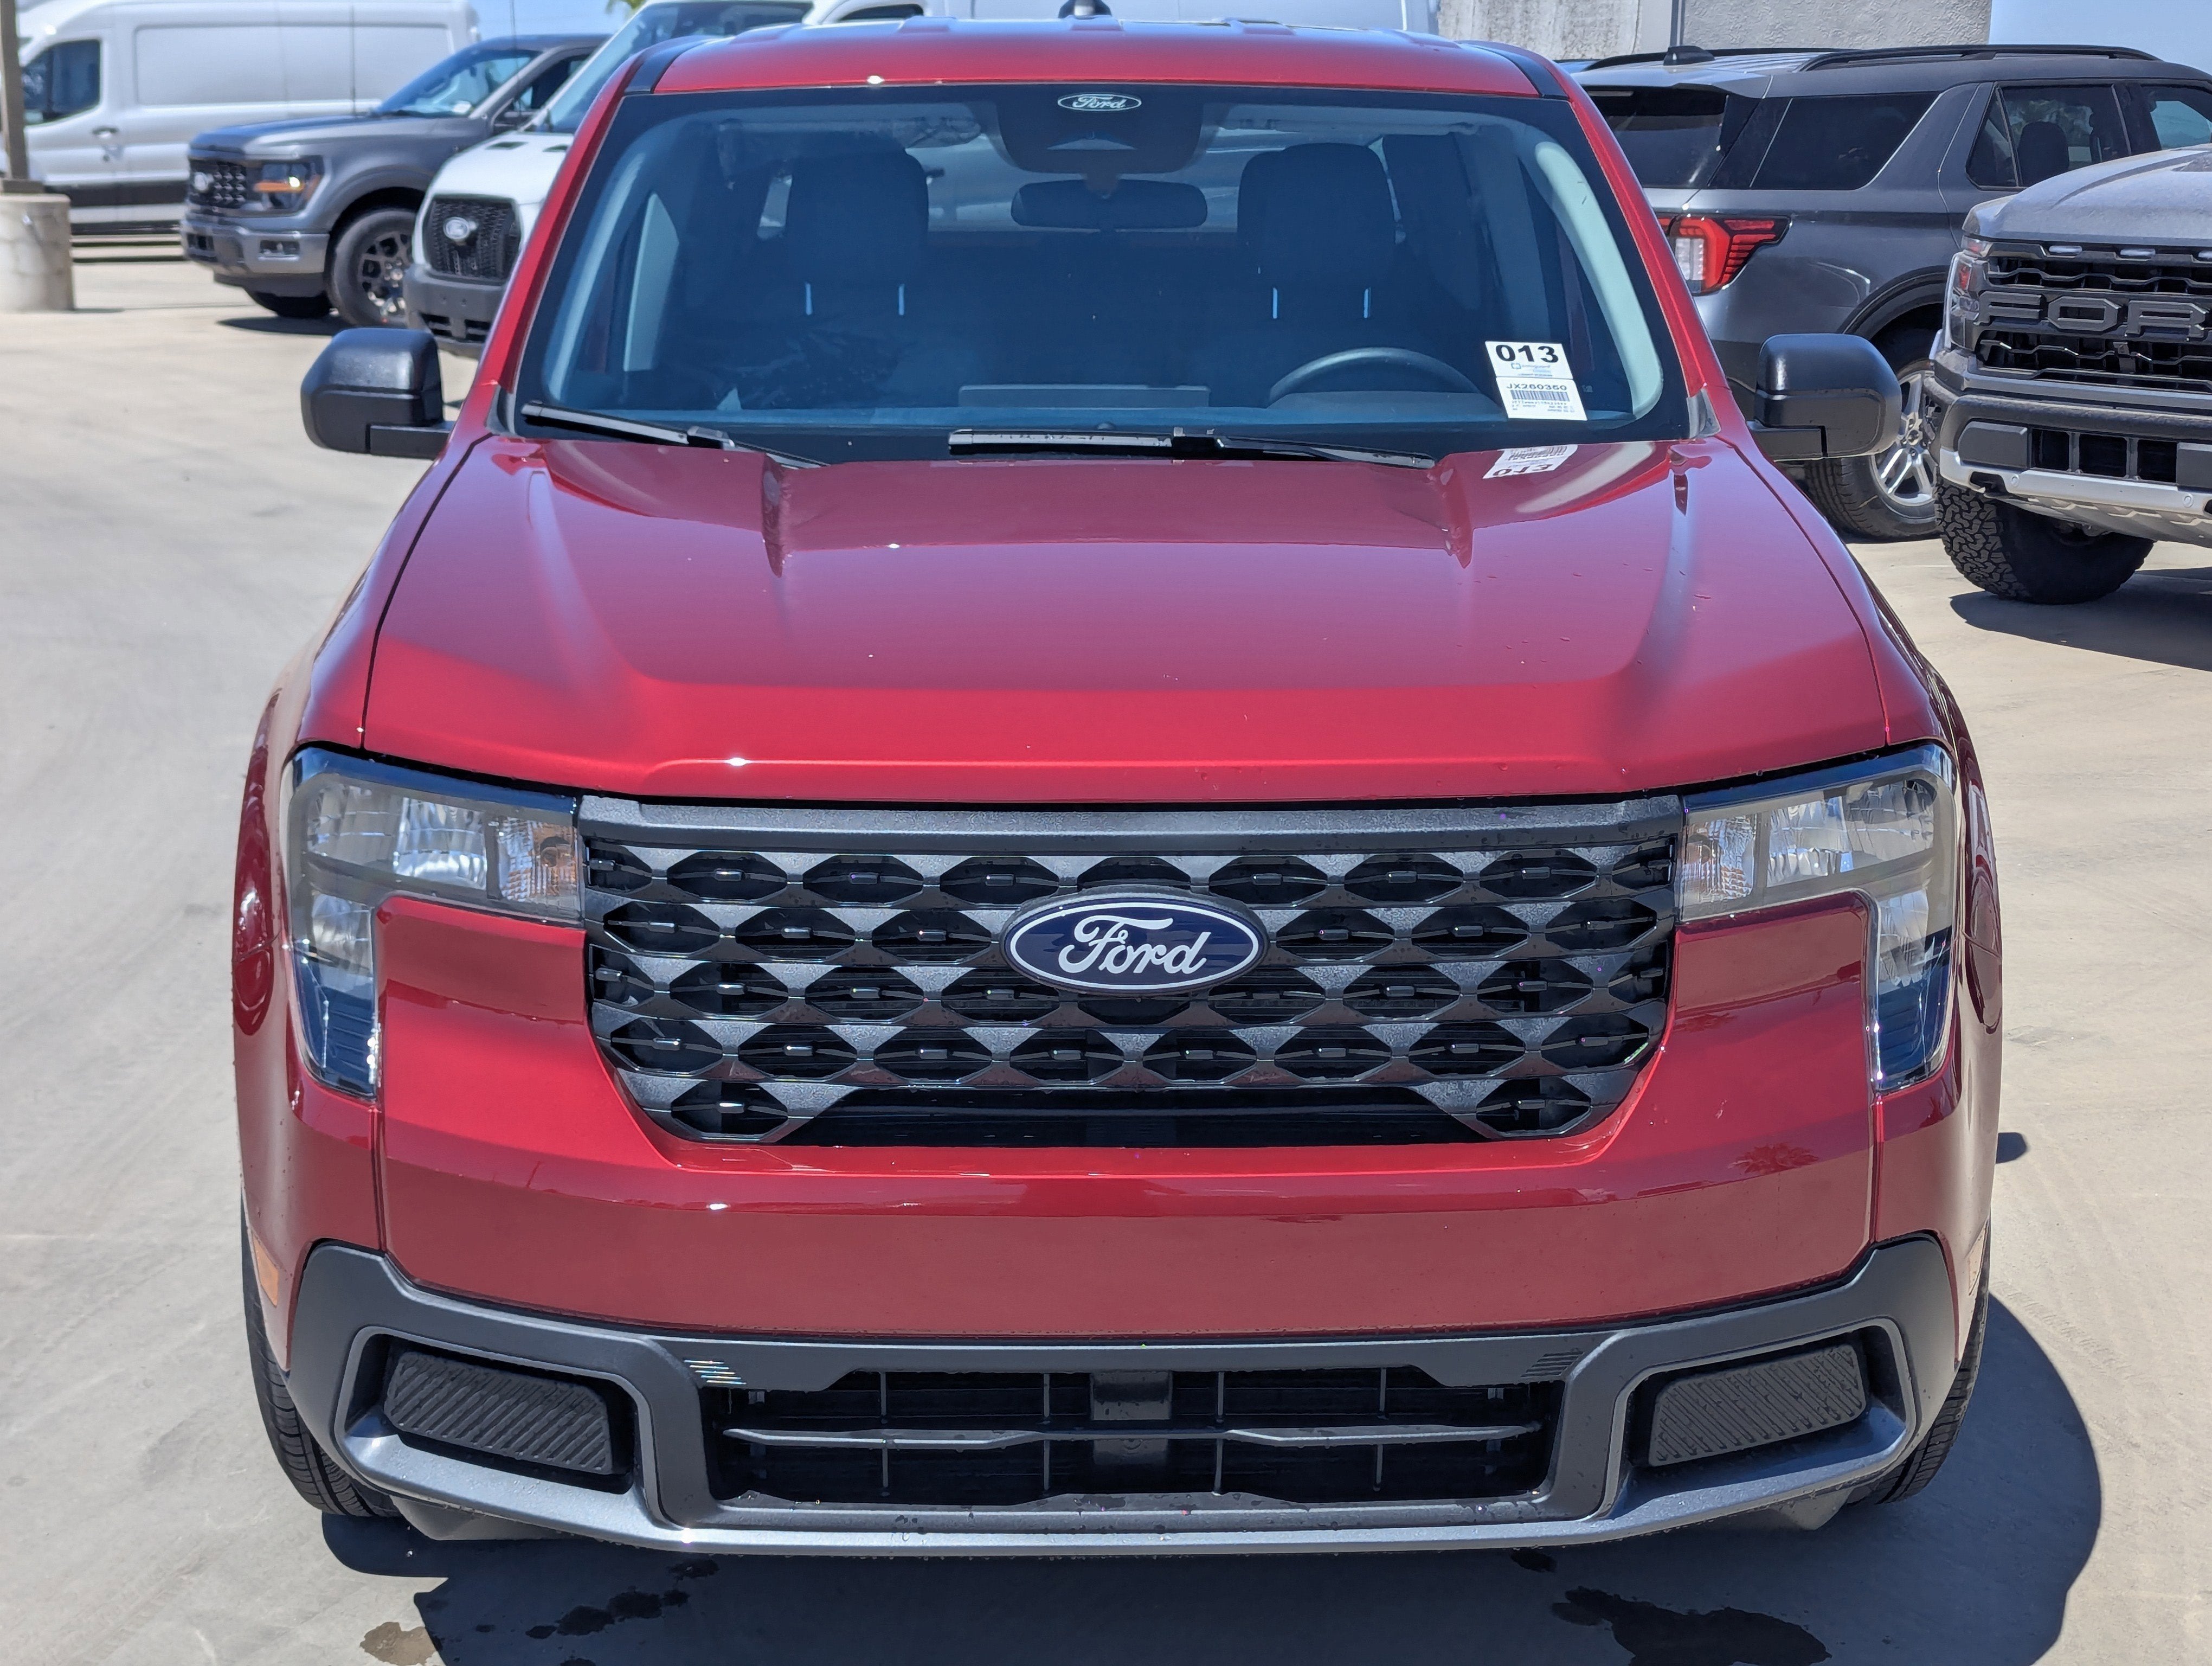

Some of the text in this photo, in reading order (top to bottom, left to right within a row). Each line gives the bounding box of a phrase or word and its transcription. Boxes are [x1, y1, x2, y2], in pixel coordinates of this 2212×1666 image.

[1072, 96, 1127, 108] Ford
[1974, 291, 2205, 337] FOR
[1495, 344, 1559, 363] 013
[1058, 915, 1212, 974] Ford
